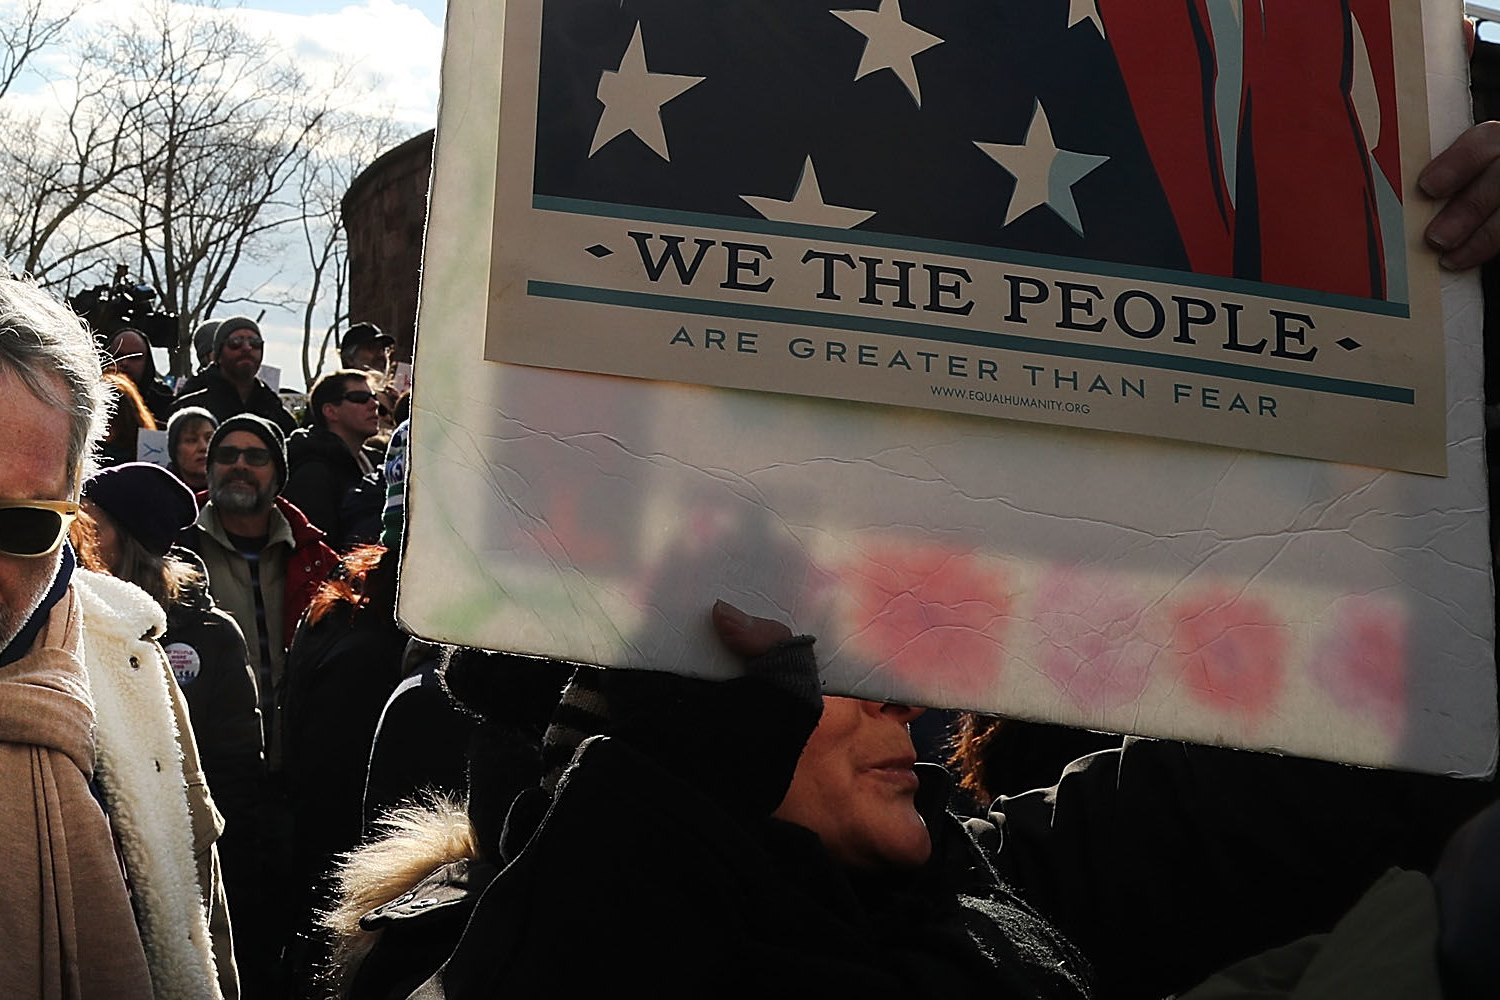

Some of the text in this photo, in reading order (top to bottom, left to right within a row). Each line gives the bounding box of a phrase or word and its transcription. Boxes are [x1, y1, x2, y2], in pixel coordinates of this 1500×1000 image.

[627, 231, 1319, 362] WE THE PEOPLE
[669, 326, 1277, 418] ARE GREATER THAN FEAR
[930, 385, 1090, 414] WWW.EQUALHUMANITY.ORG
